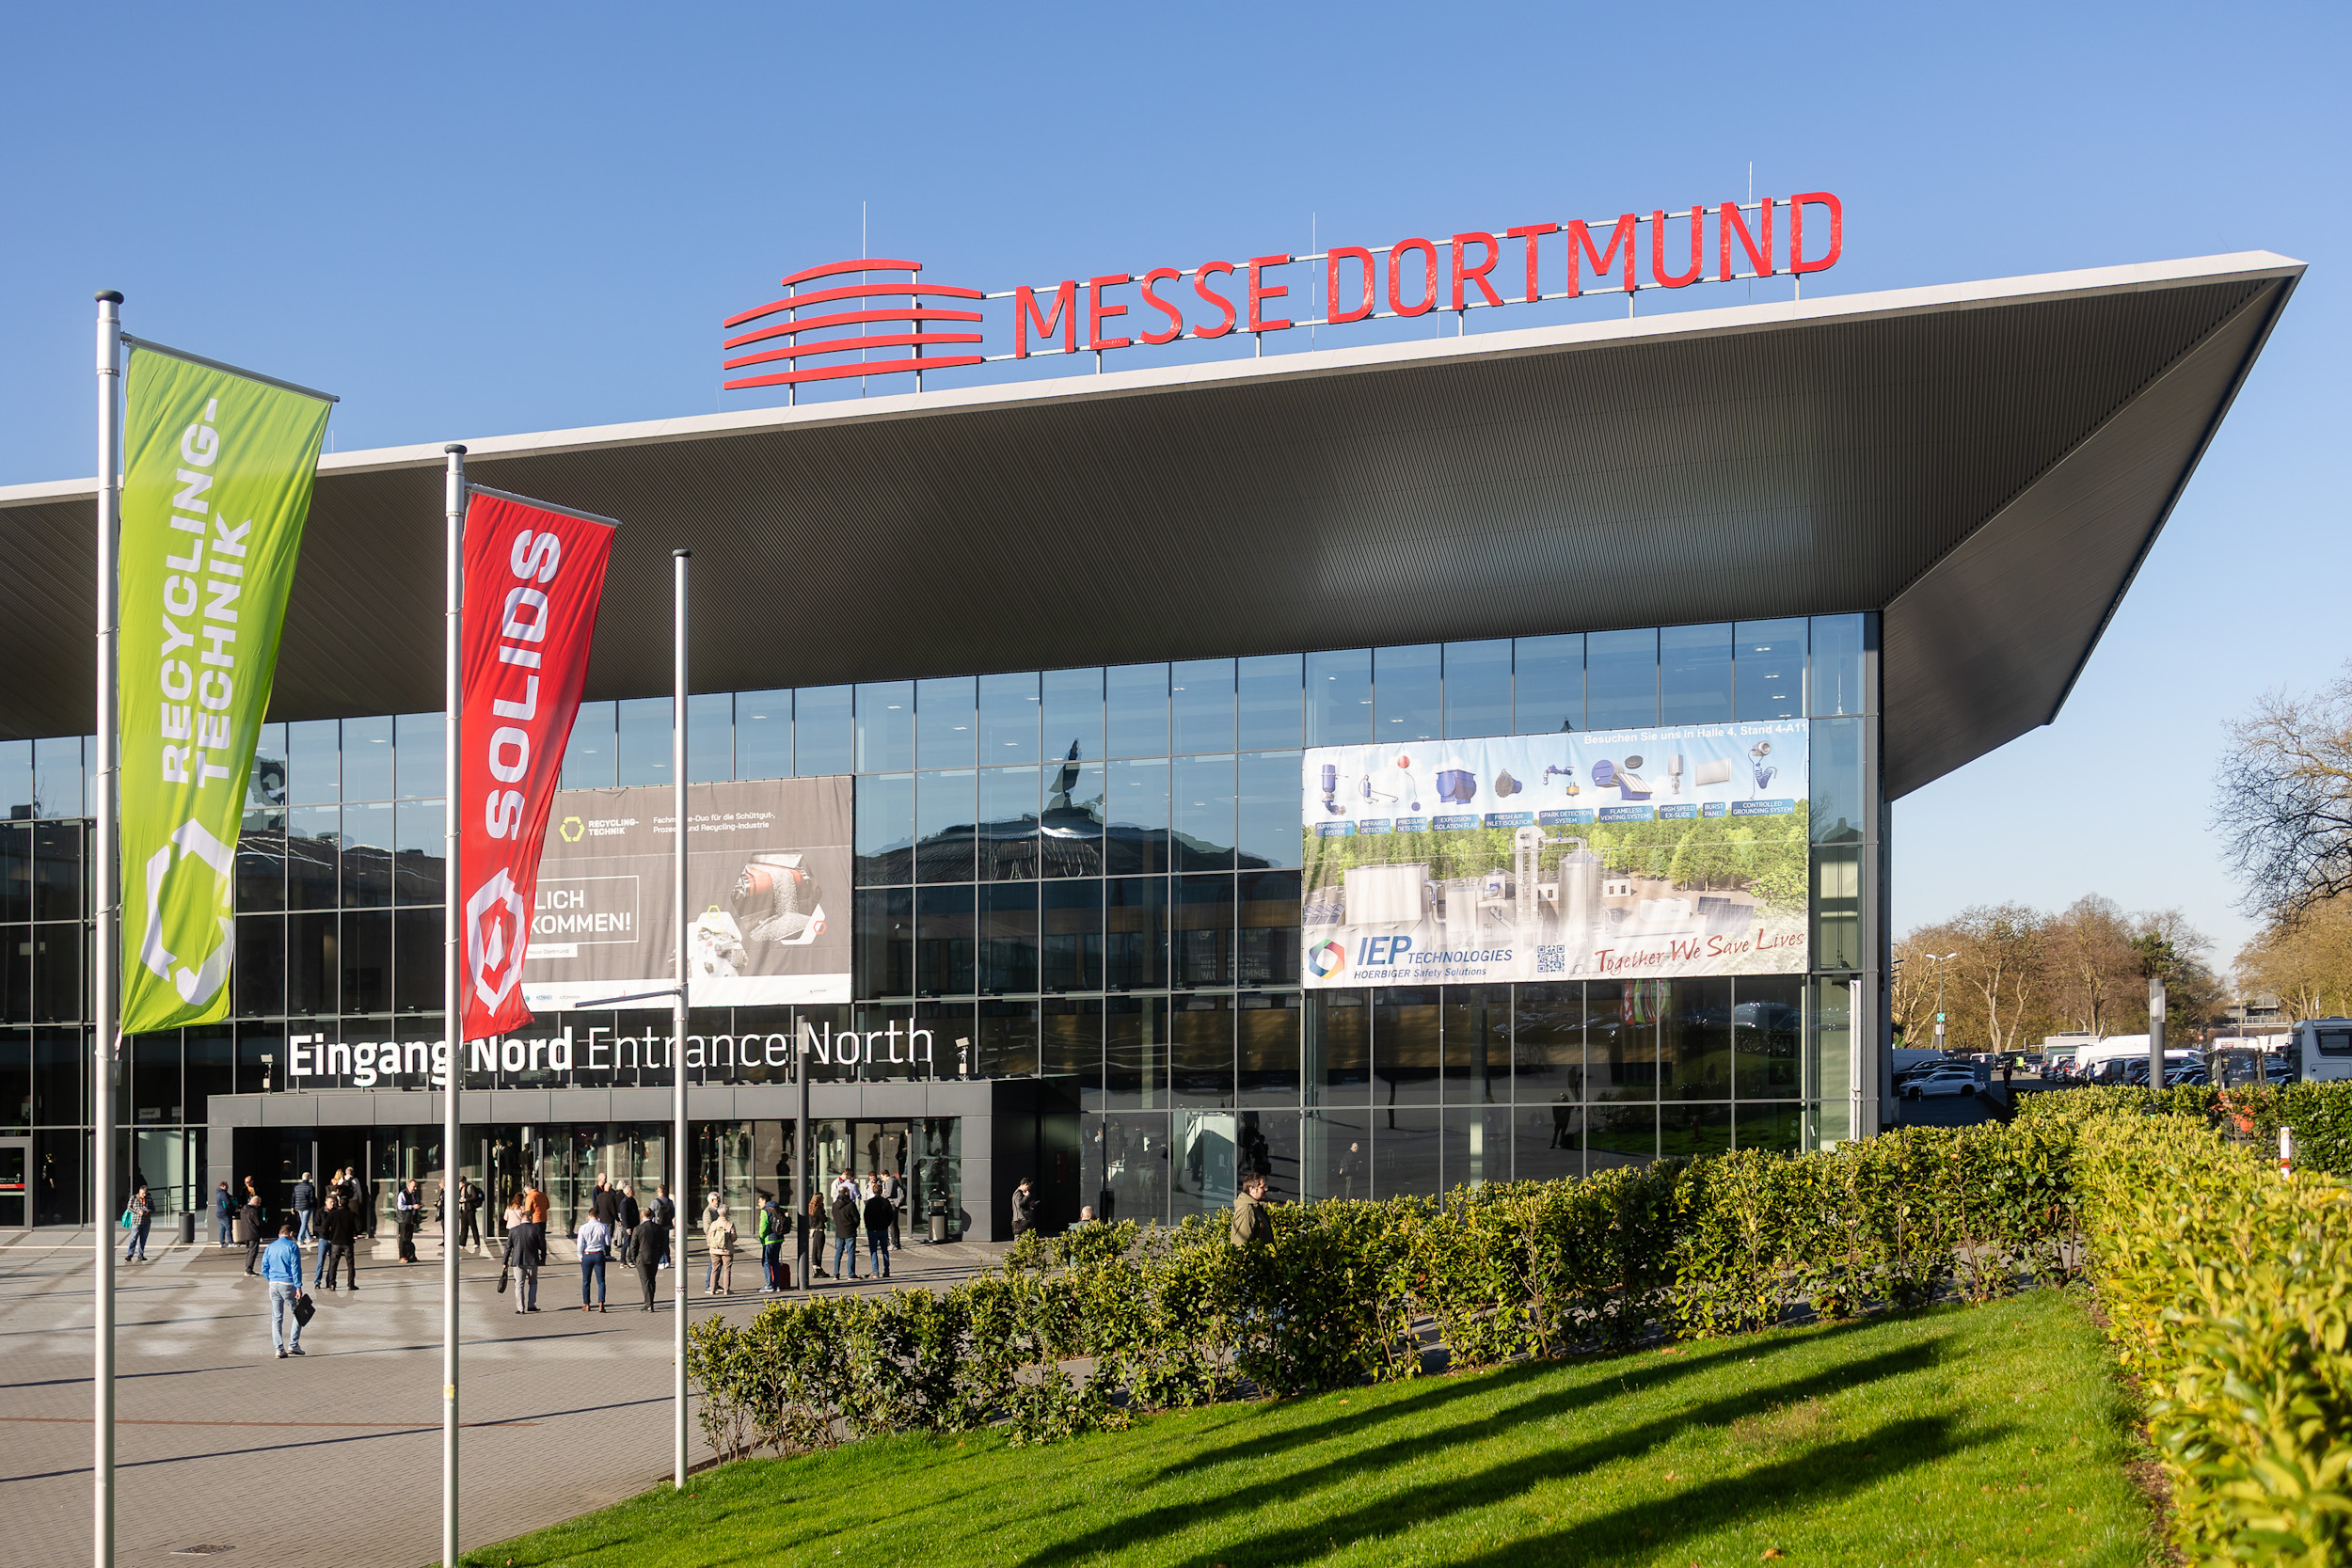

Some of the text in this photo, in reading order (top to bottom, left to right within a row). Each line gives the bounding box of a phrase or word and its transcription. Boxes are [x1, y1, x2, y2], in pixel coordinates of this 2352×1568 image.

[1015, 191, 1842, 358] MESSE DORTMUND
[160, 397, 219, 784] RECYCLING-
[196, 511, 252, 788] TECHNIK
[485, 528, 561, 841] SOLIDS
[1584, 722, 1806, 745] Besuchen Sie uns in Halle 4, Stand 4-A11
[653, 816, 709, 824] Fachme-Duo
[723, 813, 735, 821] die
[1732, 807, 1769, 816] GROUNDING
[588, 818, 640, 829] RECYCLING-
[588, 827, 627, 836] TECHNIK
[701, 821, 770, 832] Recycling-Industrie
[534, 889, 584, 911] LICH
[530, 911, 631, 935] KOMMEN!
[1357, 935, 1513, 966] IEP TECHNOLOGIES
[1595, 927, 1804, 976] Together We Save Lives
[1354, 967, 1486, 979] HOERBIGER Safety Solutions
[289, 1017, 934, 1086] Eingang Nord Entrance North
